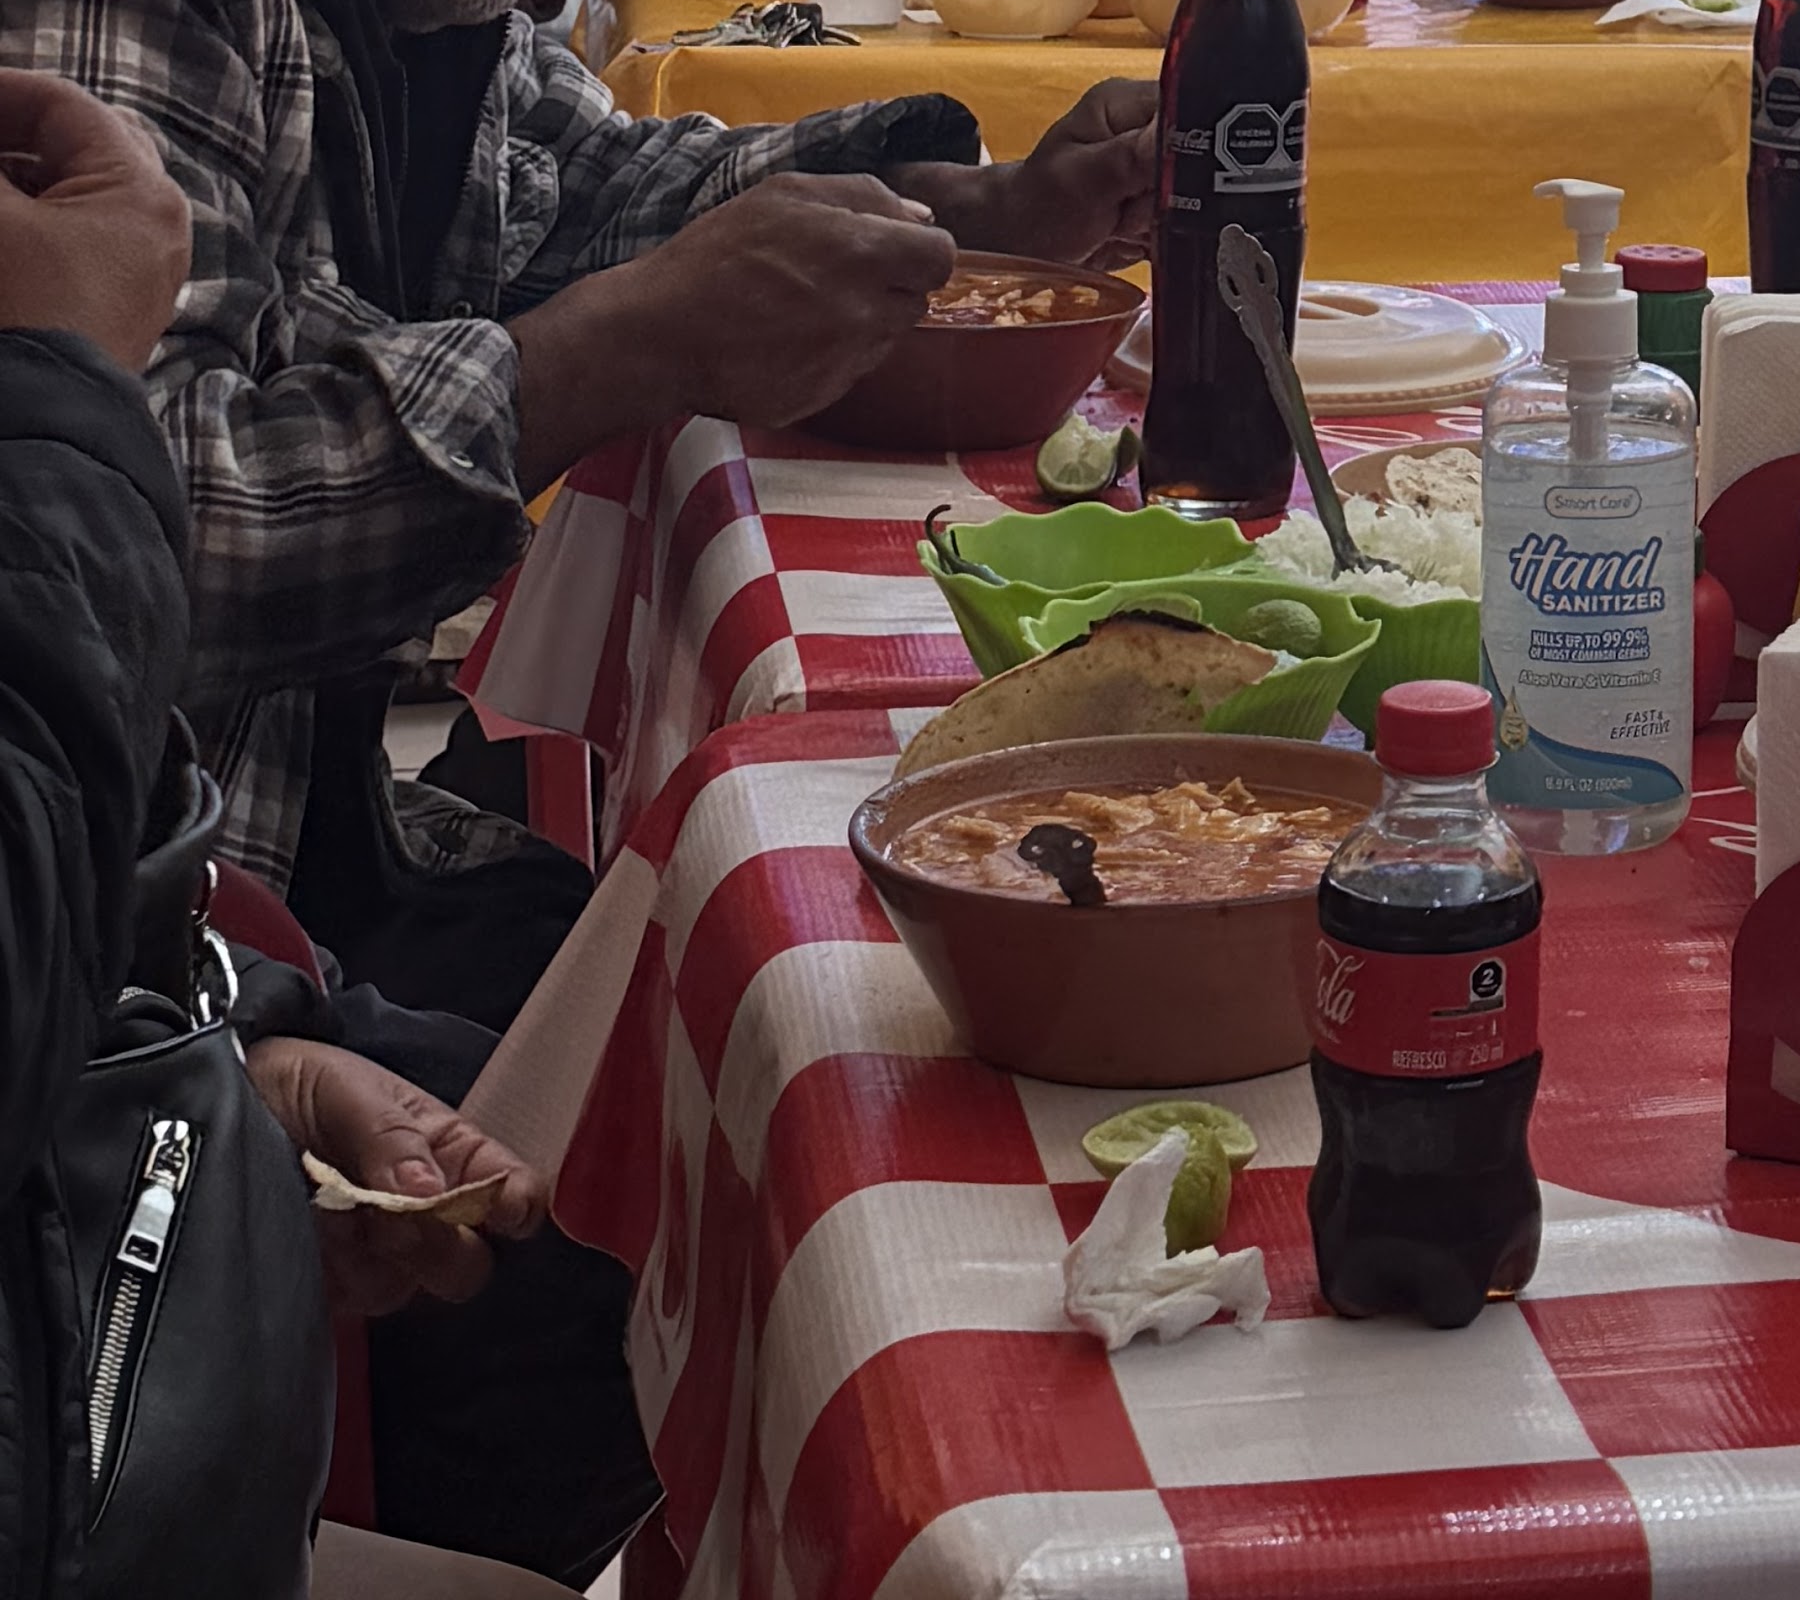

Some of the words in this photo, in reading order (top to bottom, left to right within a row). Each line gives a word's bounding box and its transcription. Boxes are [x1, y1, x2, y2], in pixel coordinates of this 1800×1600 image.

[1510, 536, 1662, 603] Hand
[1542, 588, 1664, 615] SANITIZER
[1531, 630, 1563, 648] KILLS
[1602, 628, 1648, 647] 99.9%
[1600, 671, 1650, 688] Vitamin
[1624, 709, 1656, 725] FAST
[1610, 719, 1671, 740] EFFECTIVE
[1481, 968, 1495, 986] 2
